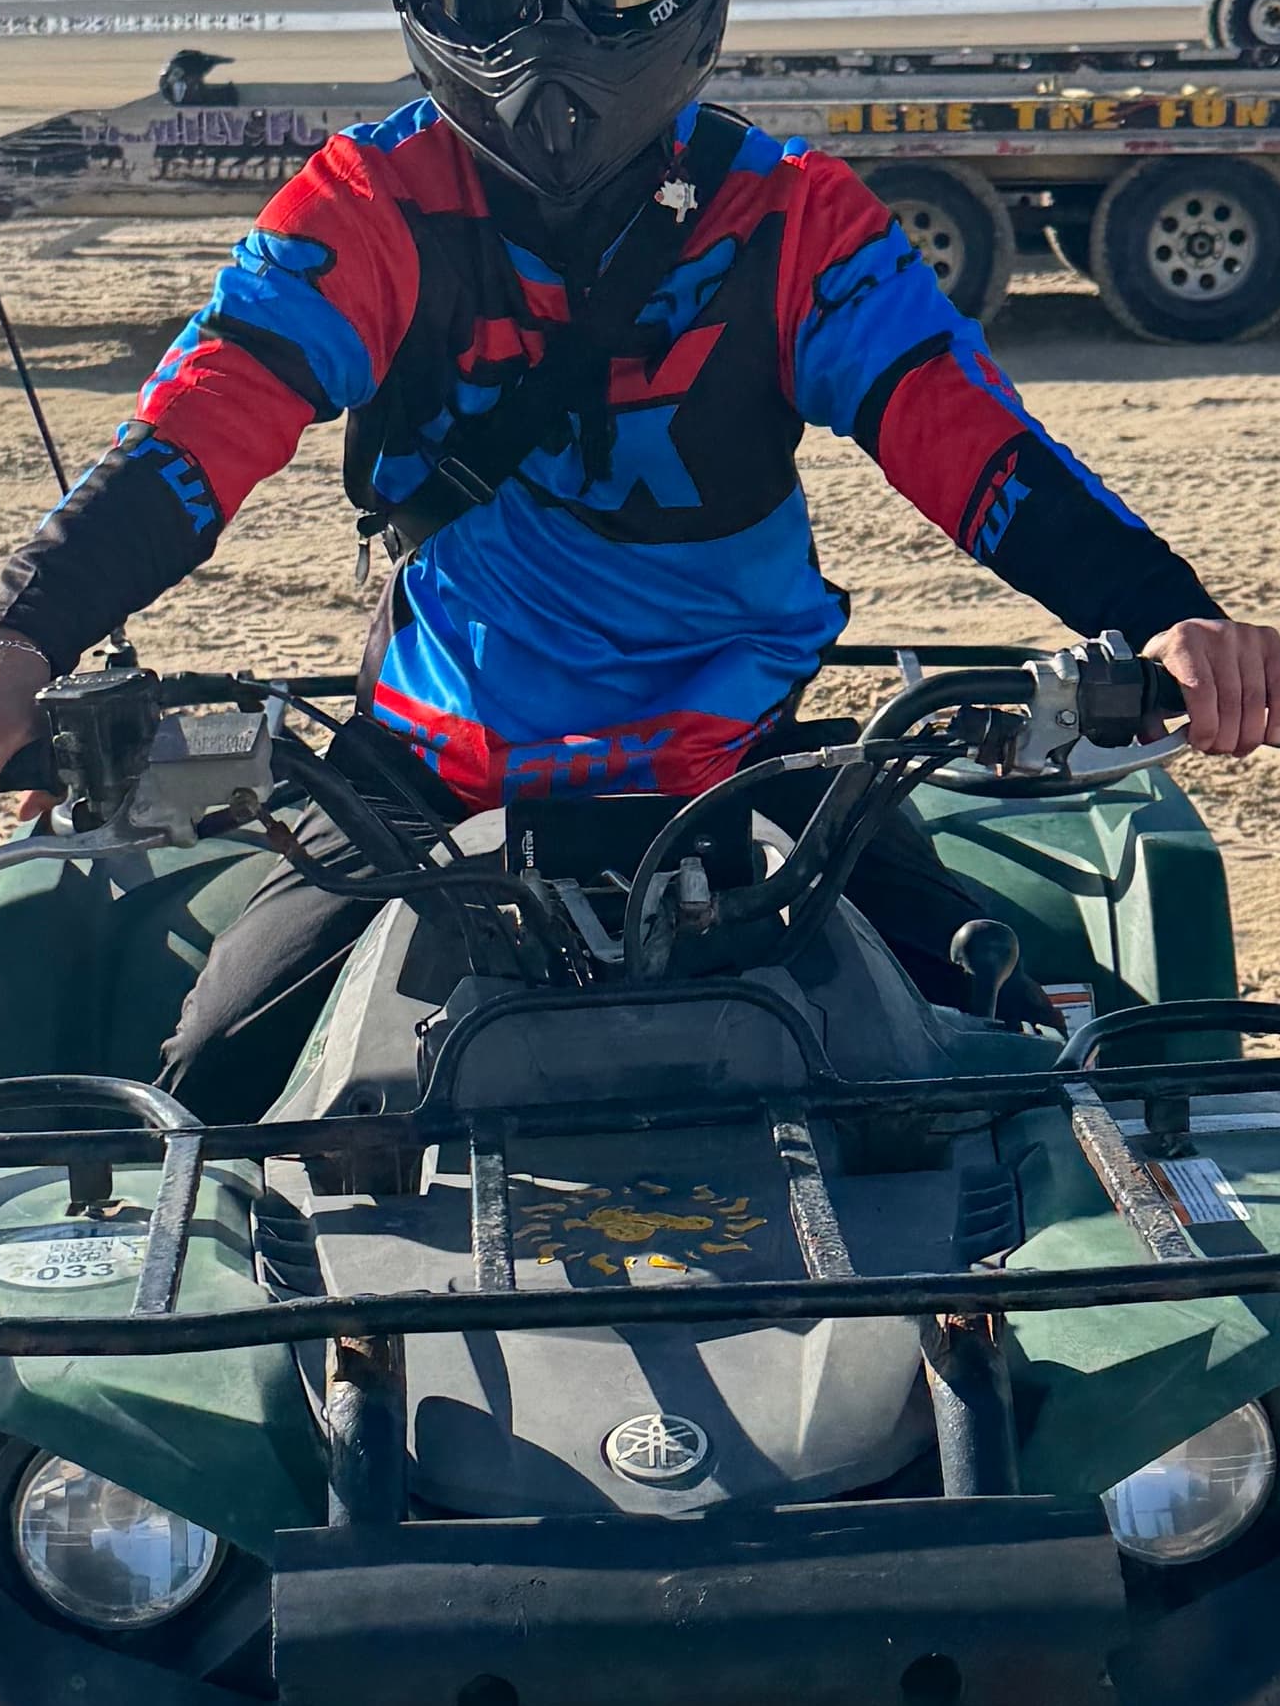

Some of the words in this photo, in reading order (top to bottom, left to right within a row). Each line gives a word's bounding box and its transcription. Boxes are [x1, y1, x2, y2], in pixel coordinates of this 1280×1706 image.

[1011, 99, 1121, 131] THE
[1158, 96, 1272, 129] FUN
[502, 727, 677, 805] FOX
[36, 1261, 116, 1282] 033
